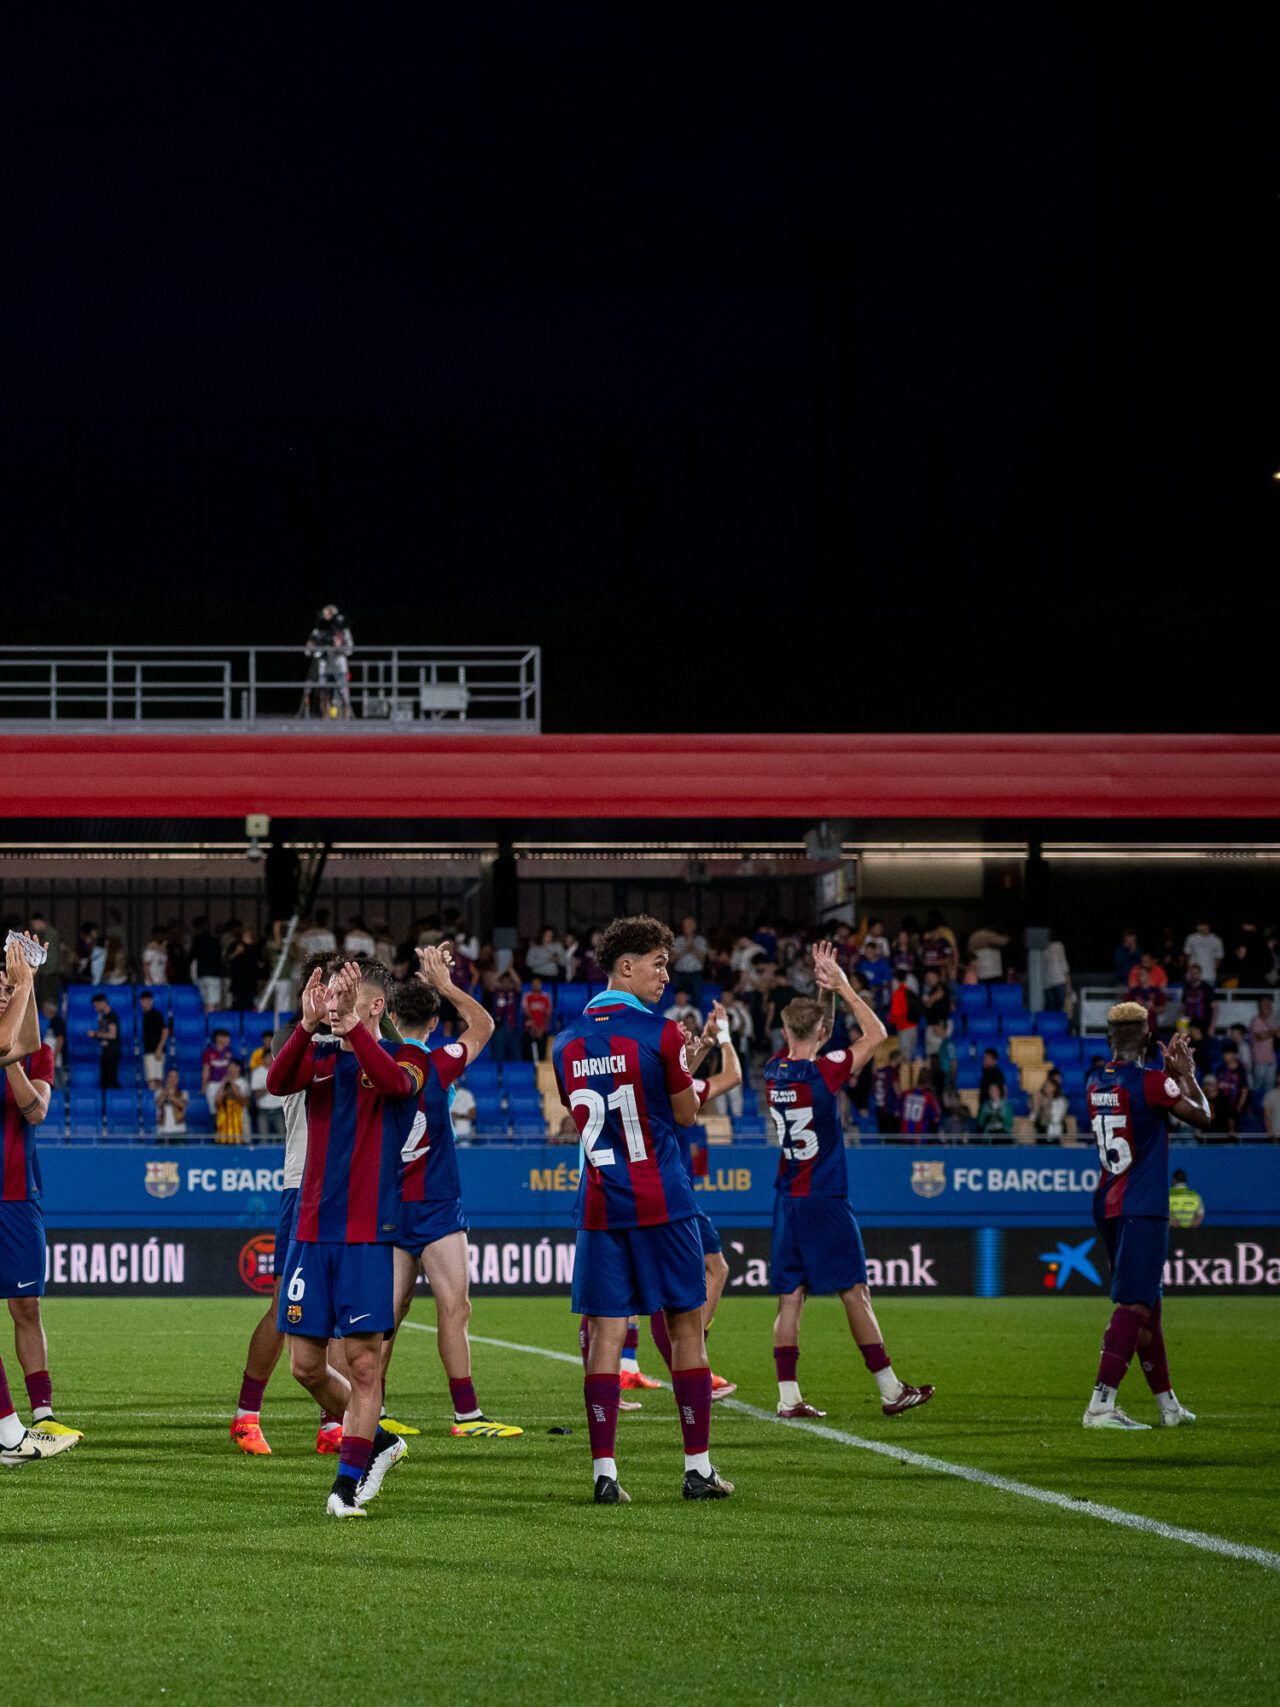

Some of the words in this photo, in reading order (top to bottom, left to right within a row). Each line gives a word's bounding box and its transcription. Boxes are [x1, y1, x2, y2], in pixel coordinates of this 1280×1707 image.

[572, 1055, 626, 1078] DARVICH
[569, 1083, 648, 1167] 21
[1091, 1115, 1132, 1175] 15
[188, 1169, 217, 1192] FC
[221, 1169, 284, 1192] BARC
[529, 1162, 580, 1191] MÉS
[953, 1168, 983, 1192] FC
[987, 1168, 1099, 1192] BARCELO
[45, 1236, 185, 1284] ERACIÓN
[468, 1236, 576, 1284] RACIÓN
[287, 1267, 306, 1302] 6
